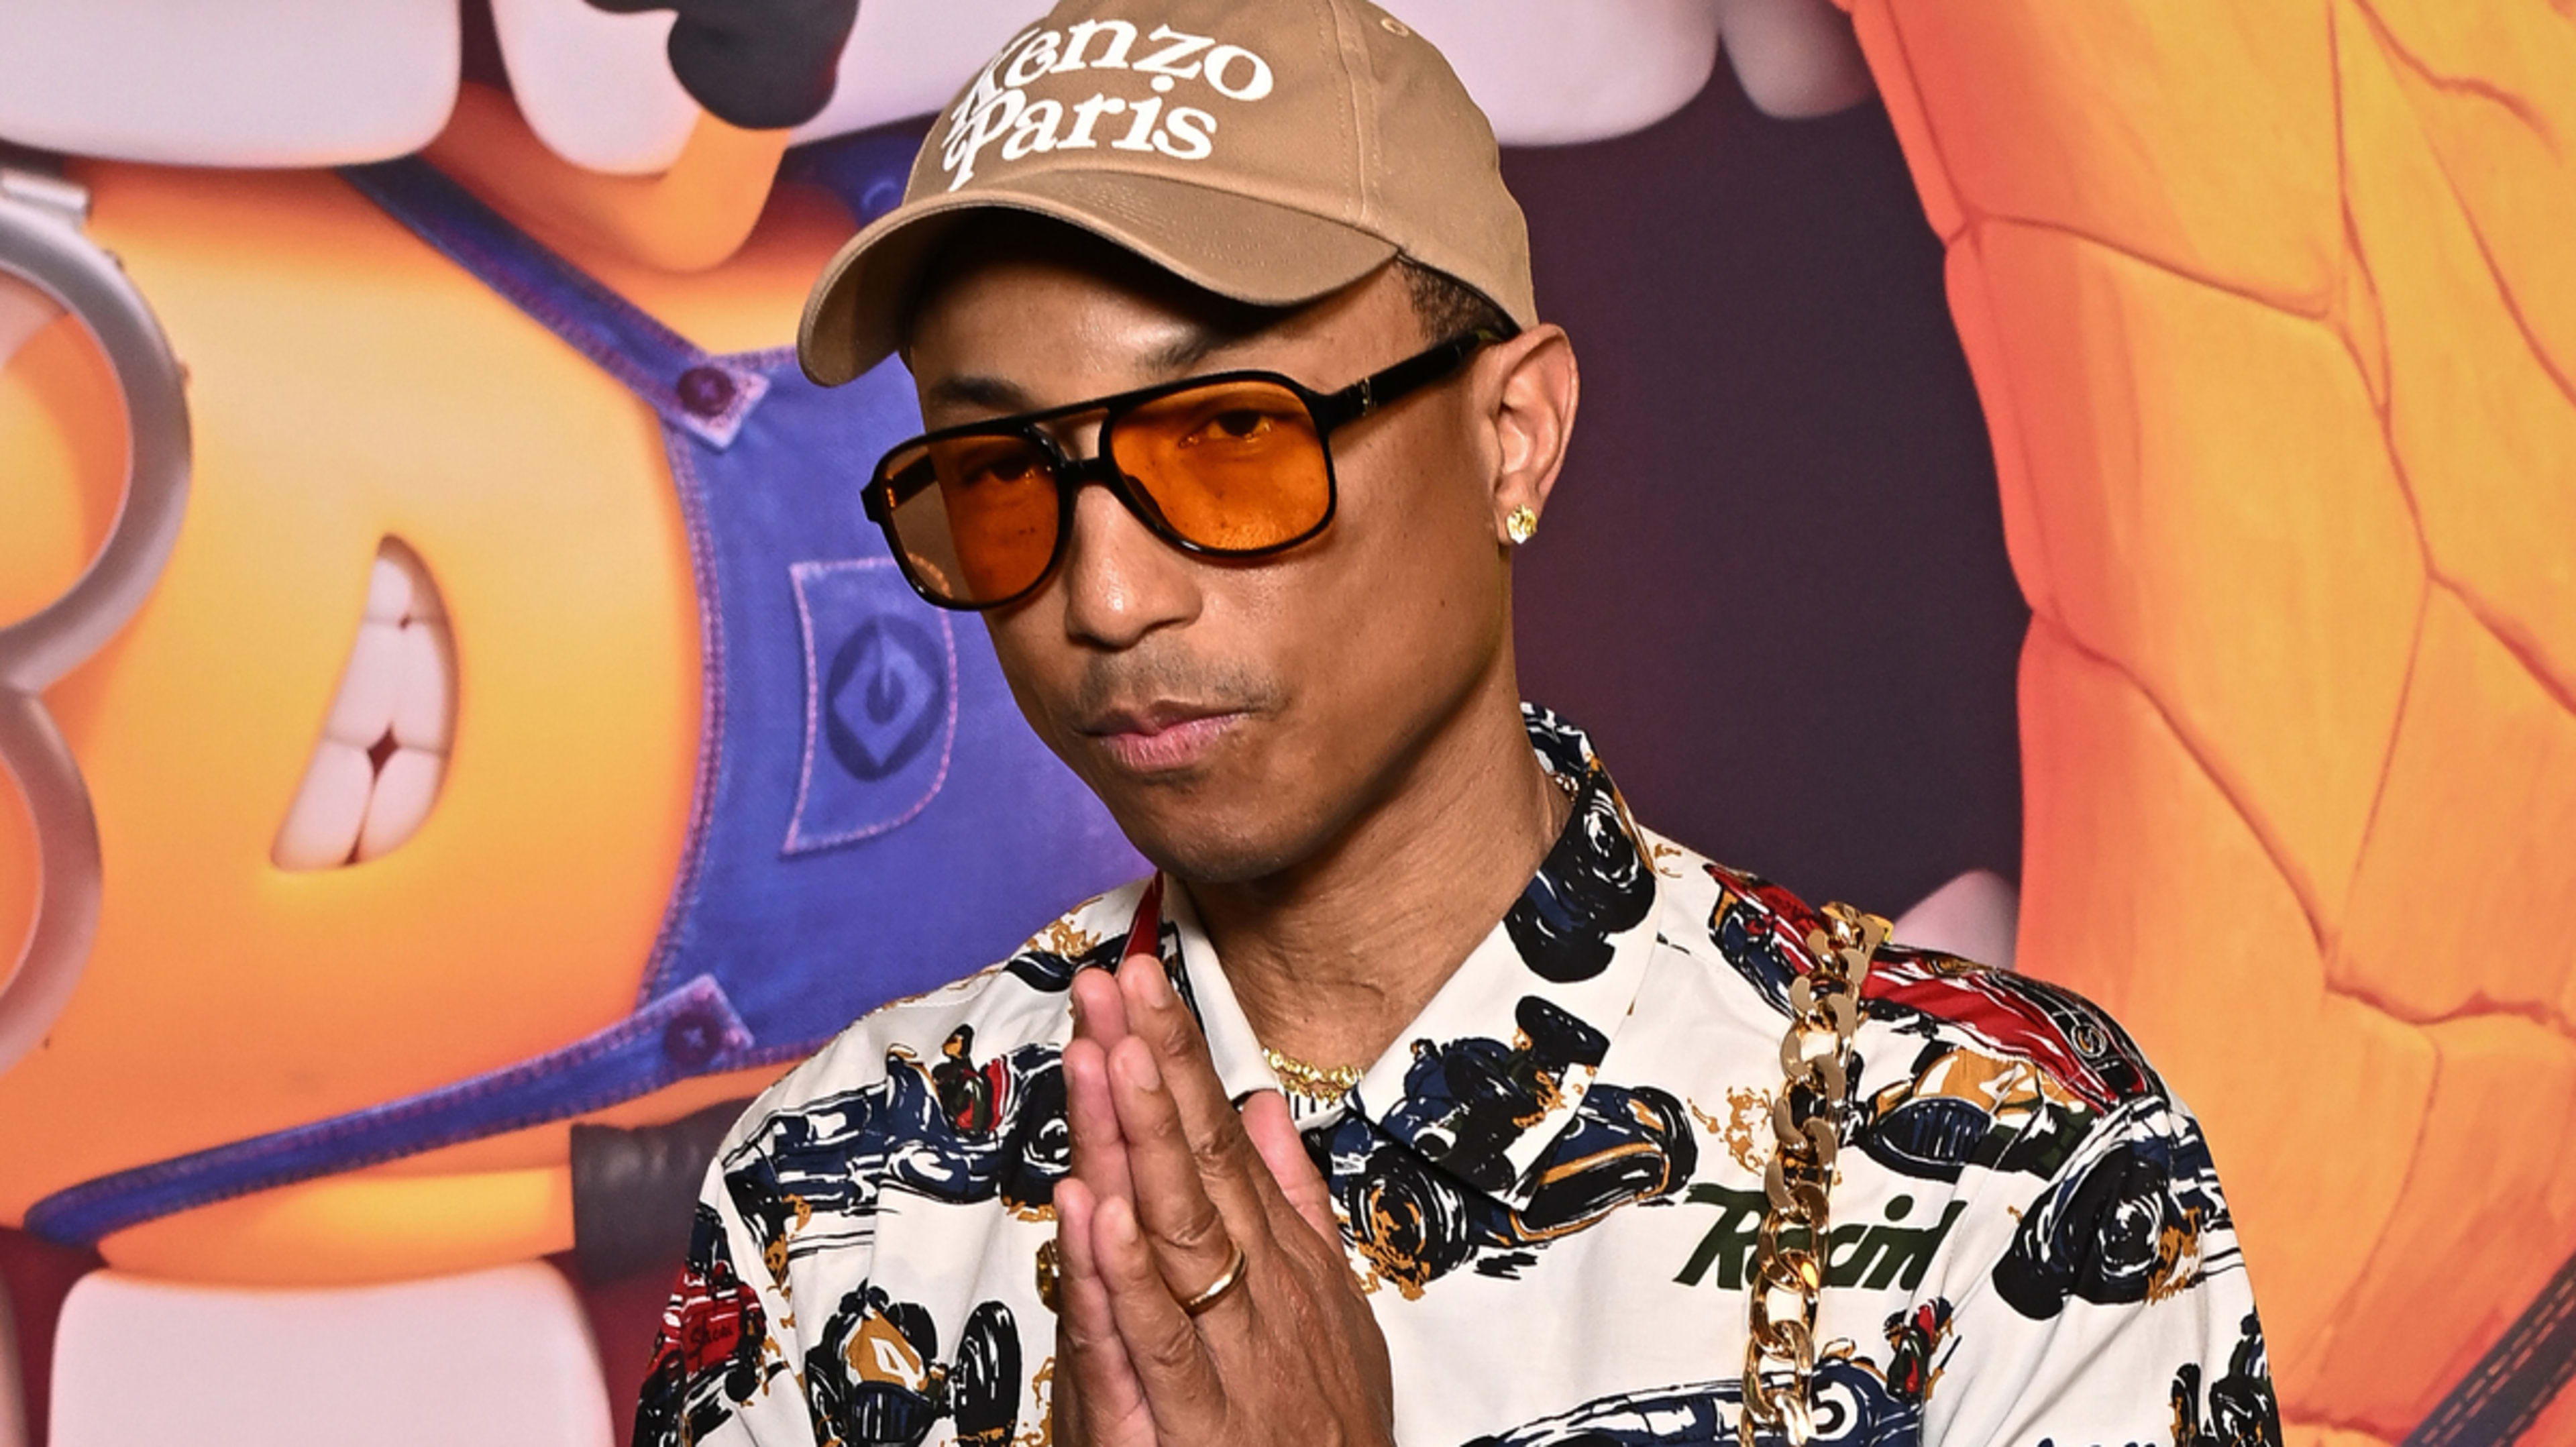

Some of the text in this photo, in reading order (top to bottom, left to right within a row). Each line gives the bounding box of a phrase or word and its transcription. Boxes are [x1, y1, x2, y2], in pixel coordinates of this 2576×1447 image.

[941, 19, 1274, 149] Kenzo
[943, 74, 1218, 192] Paris
[1811, 1381, 1845, 1436] 5
